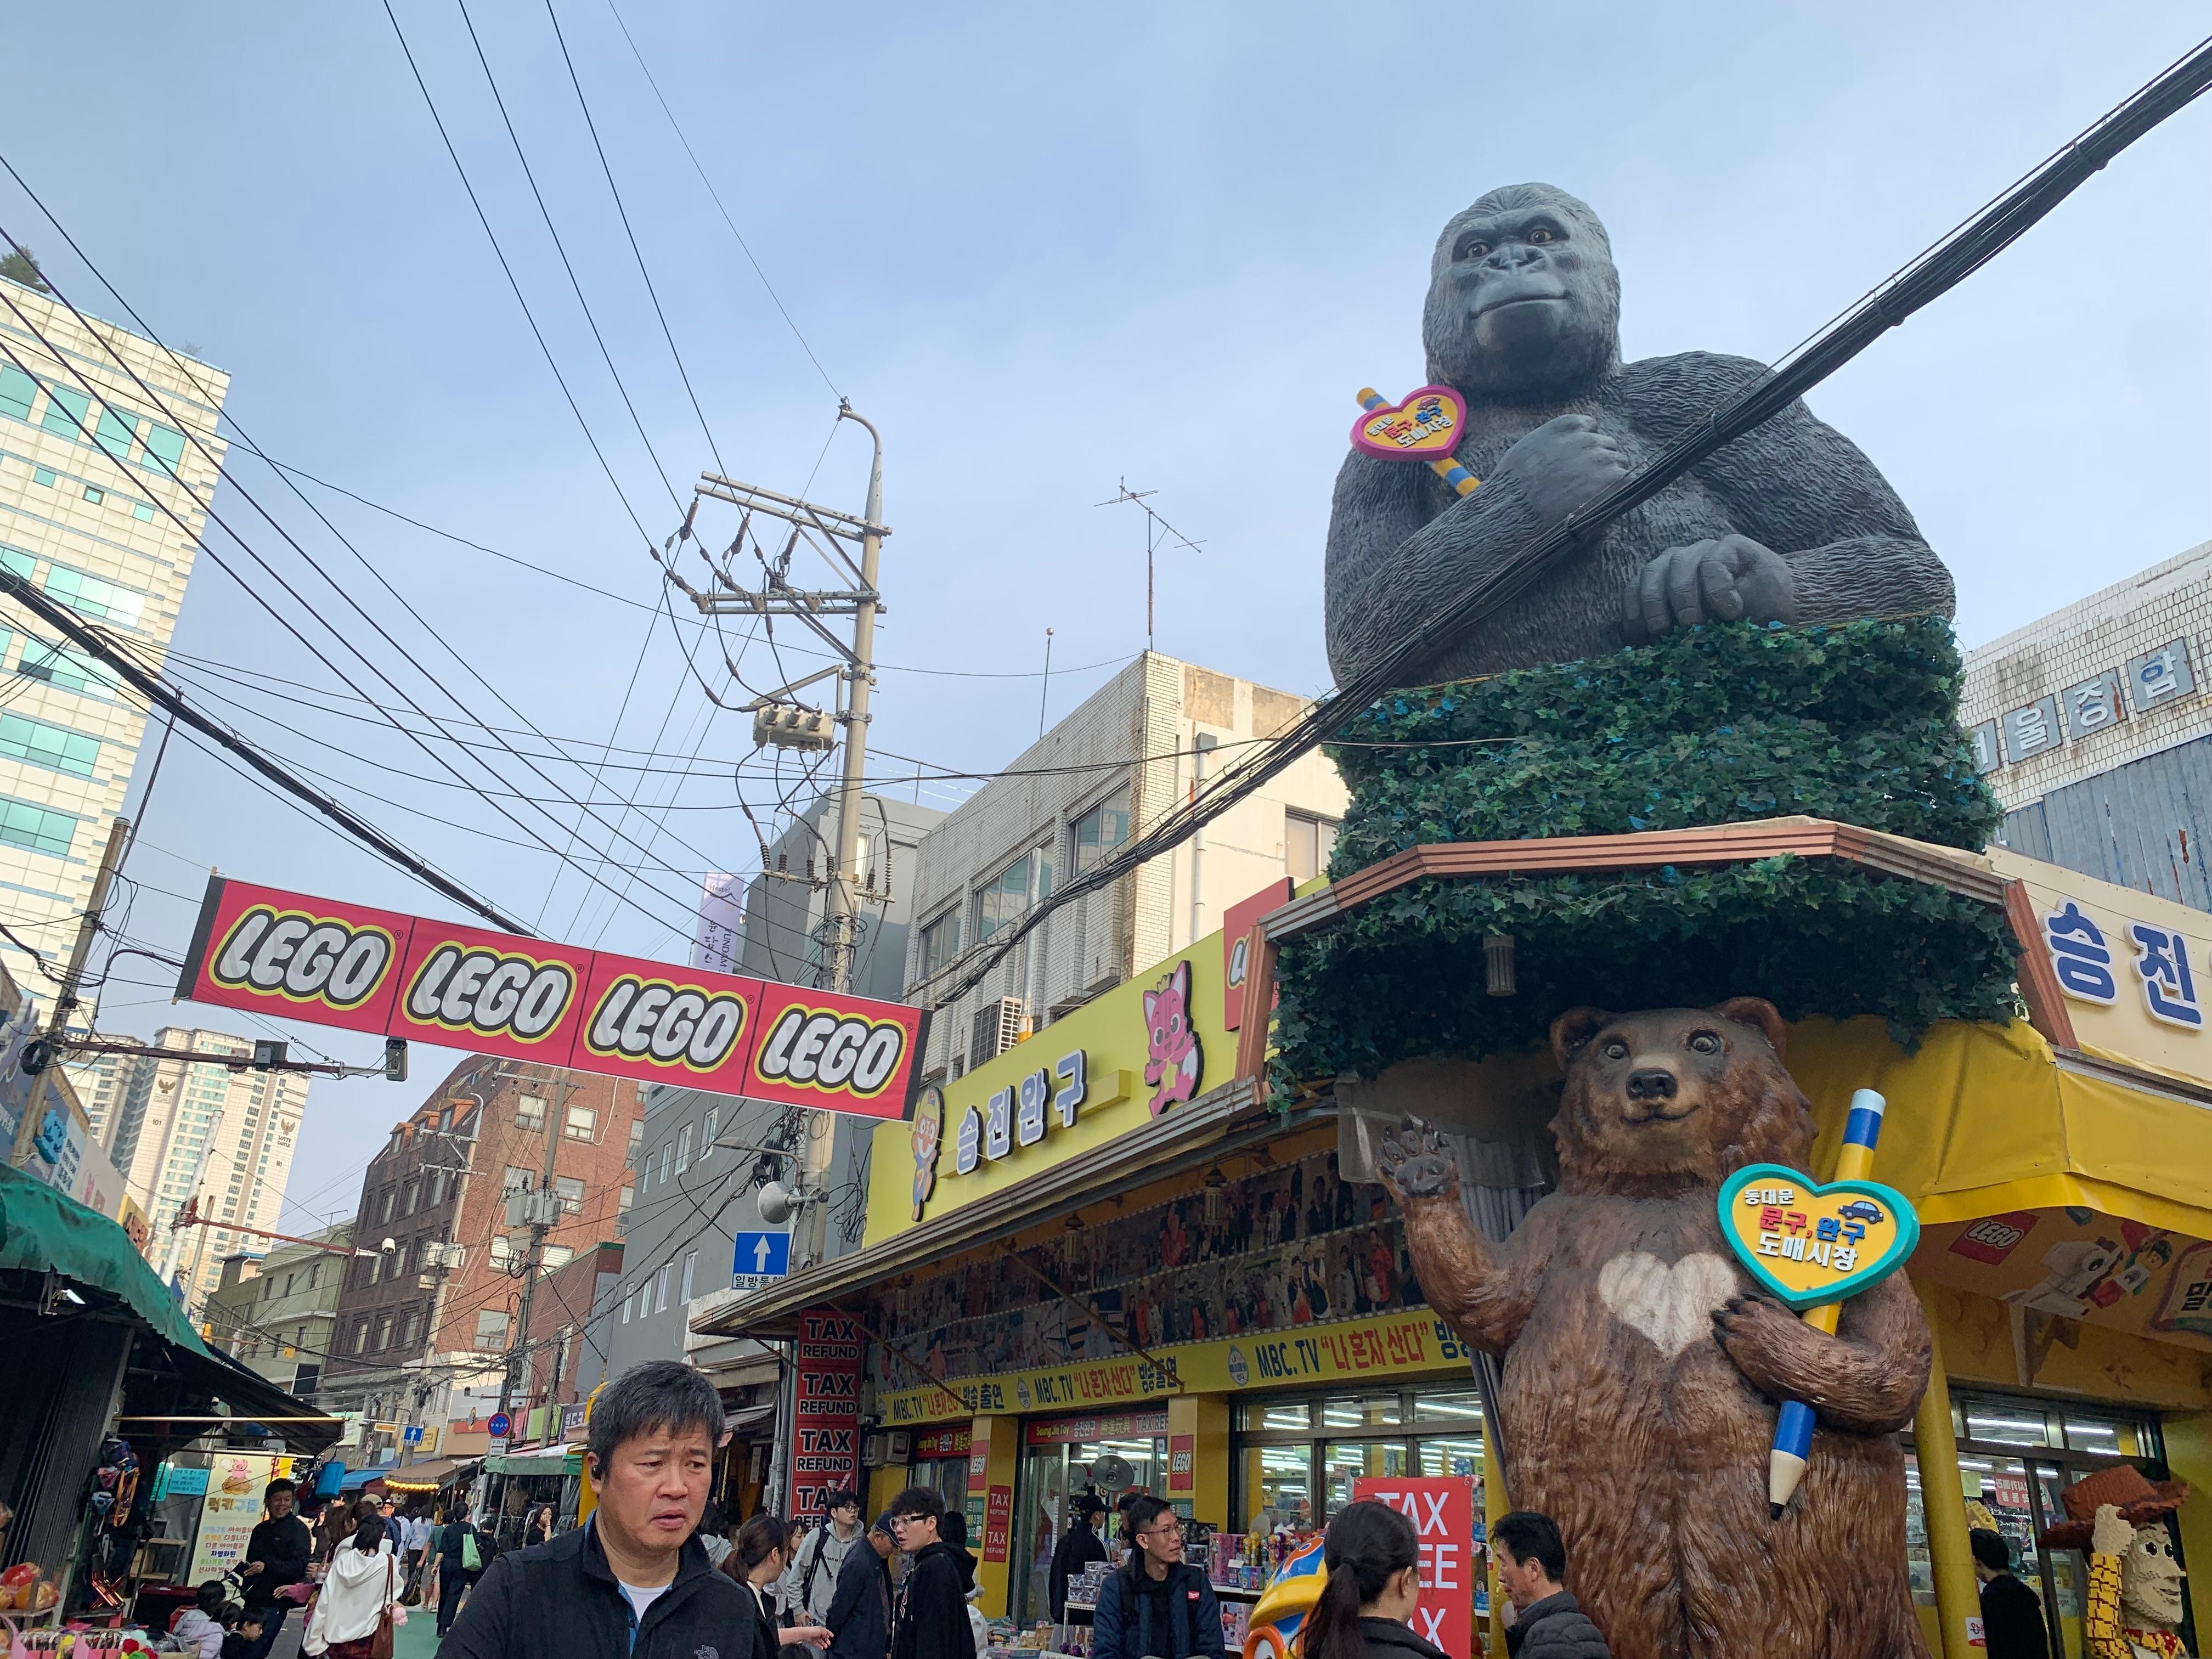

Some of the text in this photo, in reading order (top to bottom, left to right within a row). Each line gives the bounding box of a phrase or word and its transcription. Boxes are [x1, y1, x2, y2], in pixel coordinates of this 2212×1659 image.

[1367, 415, 1395, 436] 동대문
[1415, 405, 1443, 424] 완구
[1396, 415, 1454, 448] 도매시장
[709, 884, 731, 893] Hostel
[2042, 898, 2204, 1030] 승진
[215, 909, 906, 1095] LEGO LEGO LEGO LEGO
[957, 1048, 1087, 1175] 승진완구
[278, 1135, 292, 1143] LOTTE
[1743, 1188, 1795, 1206] 동대문
[1816, 1216, 1866, 1245] 완구
[1966, 1220, 2024, 1248] LEGO
[1756, 1231, 1859, 1272] 도매시장
[805, 1318, 856, 1341] TAX
[1433, 1318, 1470, 1359] 방
[802, 1344, 859, 1359] REFUND
[803, 1373, 855, 1397] TAX
[799, 1399, 856, 1415] REFUND
[1074, 1419, 1096, 1437] 승진완구
[1136, 1412, 1169, 1434] TAX REF
[799, 1429, 853, 1453] TAX
[796, 1456, 854, 1472] REFUND
[970, 1455, 986, 1474] LEGO
[1171, 1450, 1192, 1475] LEGO
[797, 1486, 830, 1510] TA
[991, 1492, 1009, 1506] TAX
[989, 1508, 1008, 1516] REFUND
[988, 1531, 1007, 1545] TAX
[1418, 1544, 1458, 1589] EE
